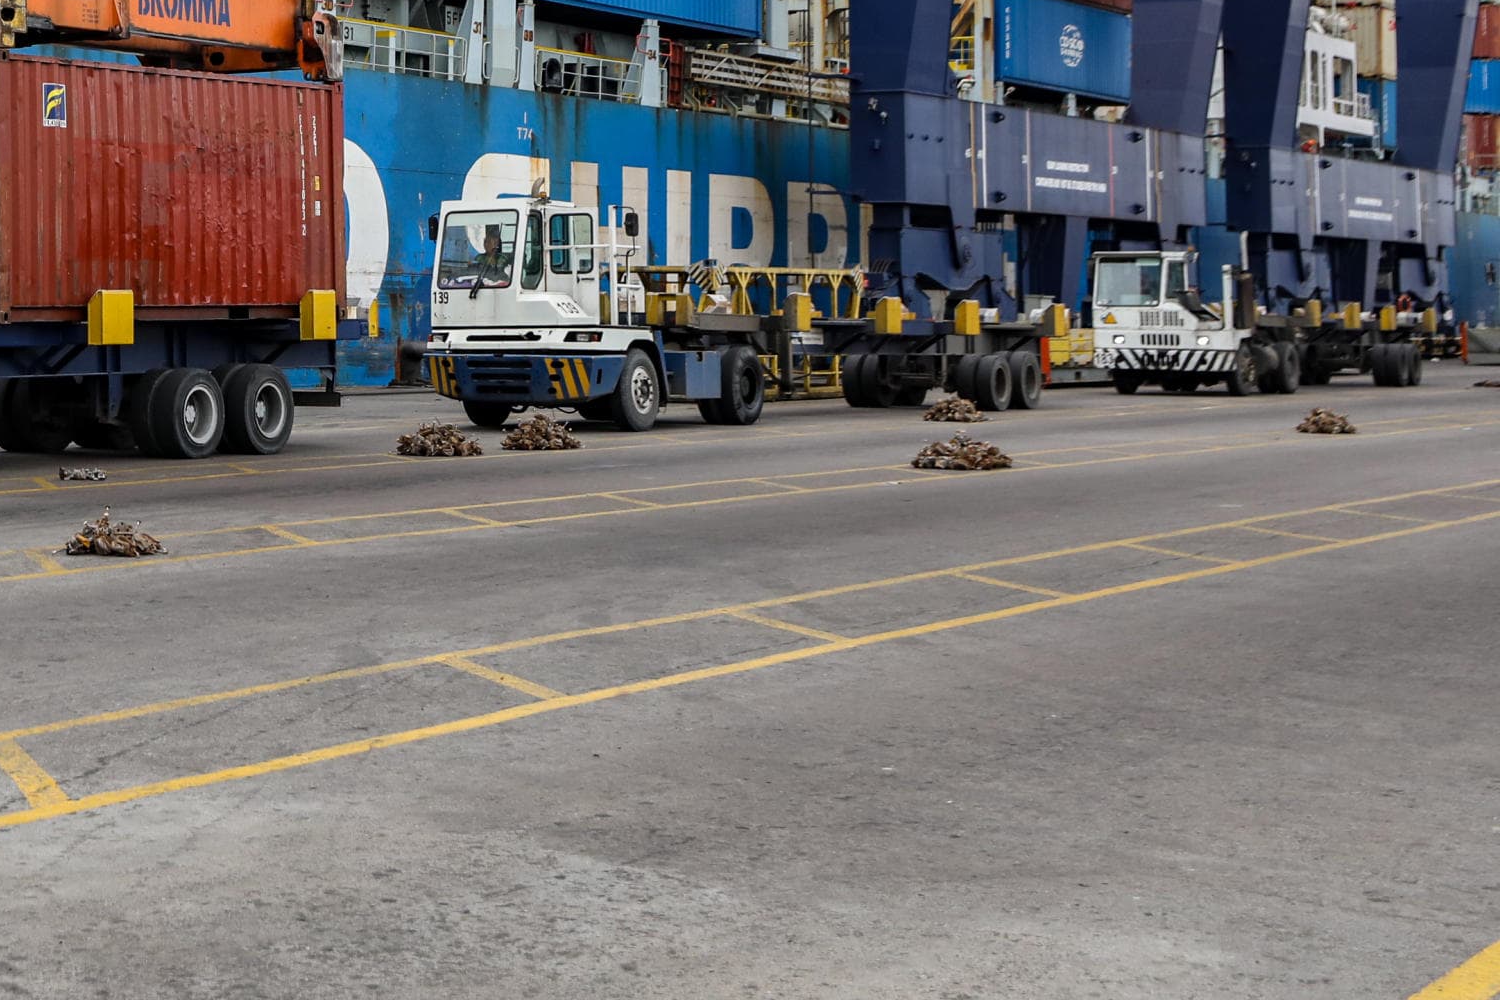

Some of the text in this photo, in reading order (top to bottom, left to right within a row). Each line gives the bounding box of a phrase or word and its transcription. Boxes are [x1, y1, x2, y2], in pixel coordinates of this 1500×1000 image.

[343, 26, 354, 41] 31
[472, 21, 482, 35] 31
[433, 292, 449, 305] 139
